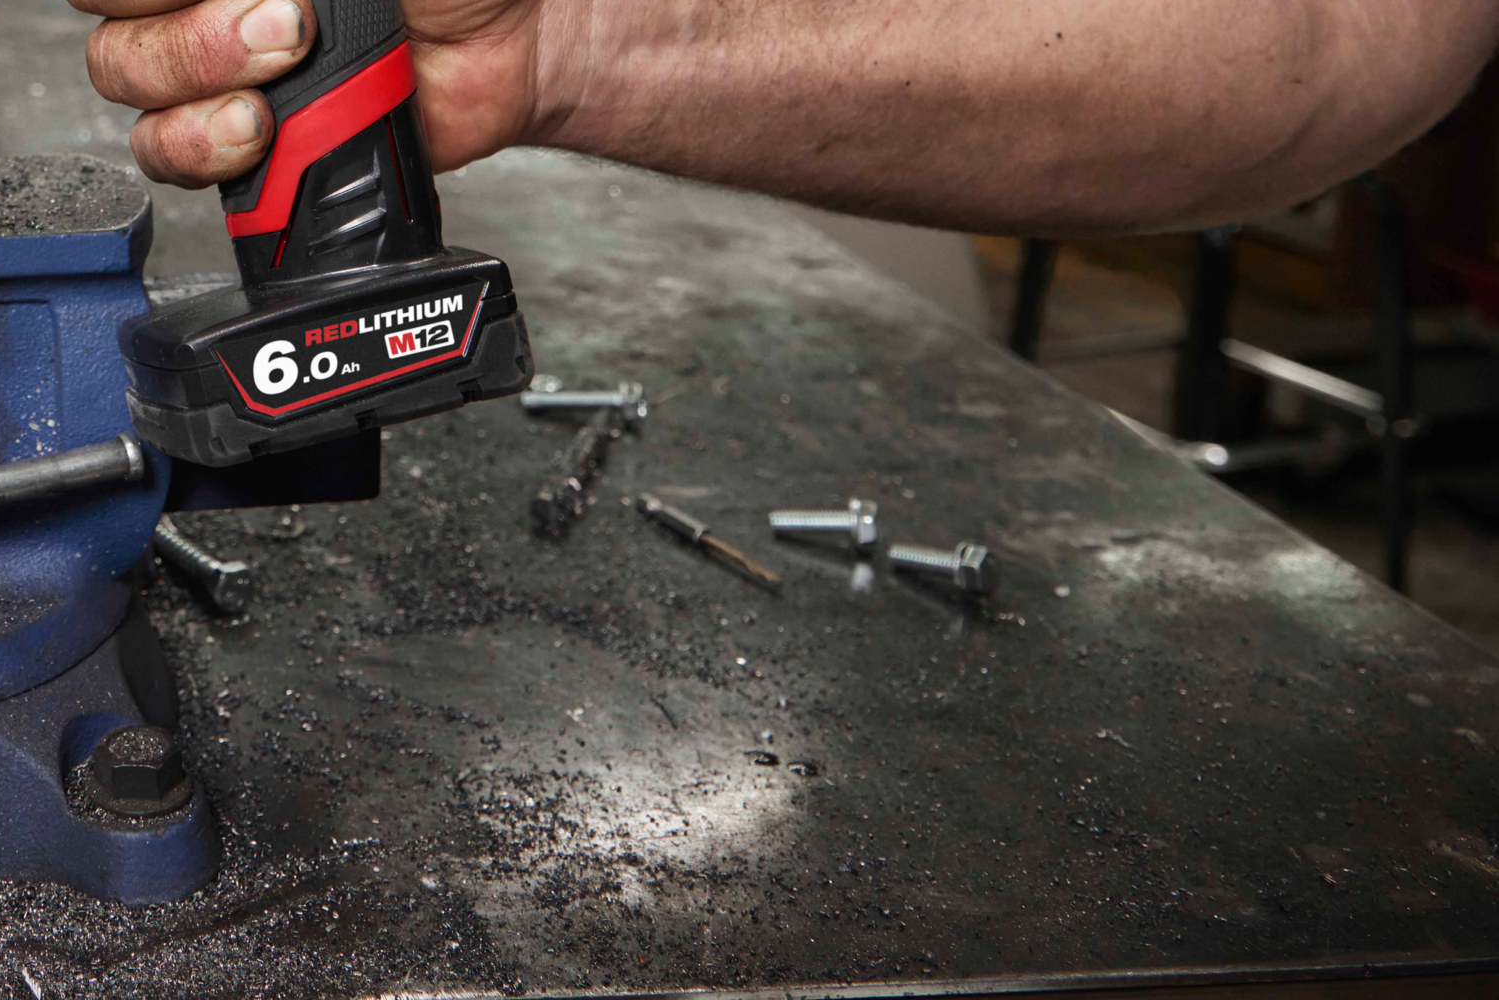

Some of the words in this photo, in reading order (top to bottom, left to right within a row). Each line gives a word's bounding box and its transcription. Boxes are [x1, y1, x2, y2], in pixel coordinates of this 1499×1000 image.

[304, 294, 464, 347] REDLITHIUM
[389, 323, 450, 356] M12
[252, 339, 339, 395] 6.0
[341, 361, 361, 376] Ah
